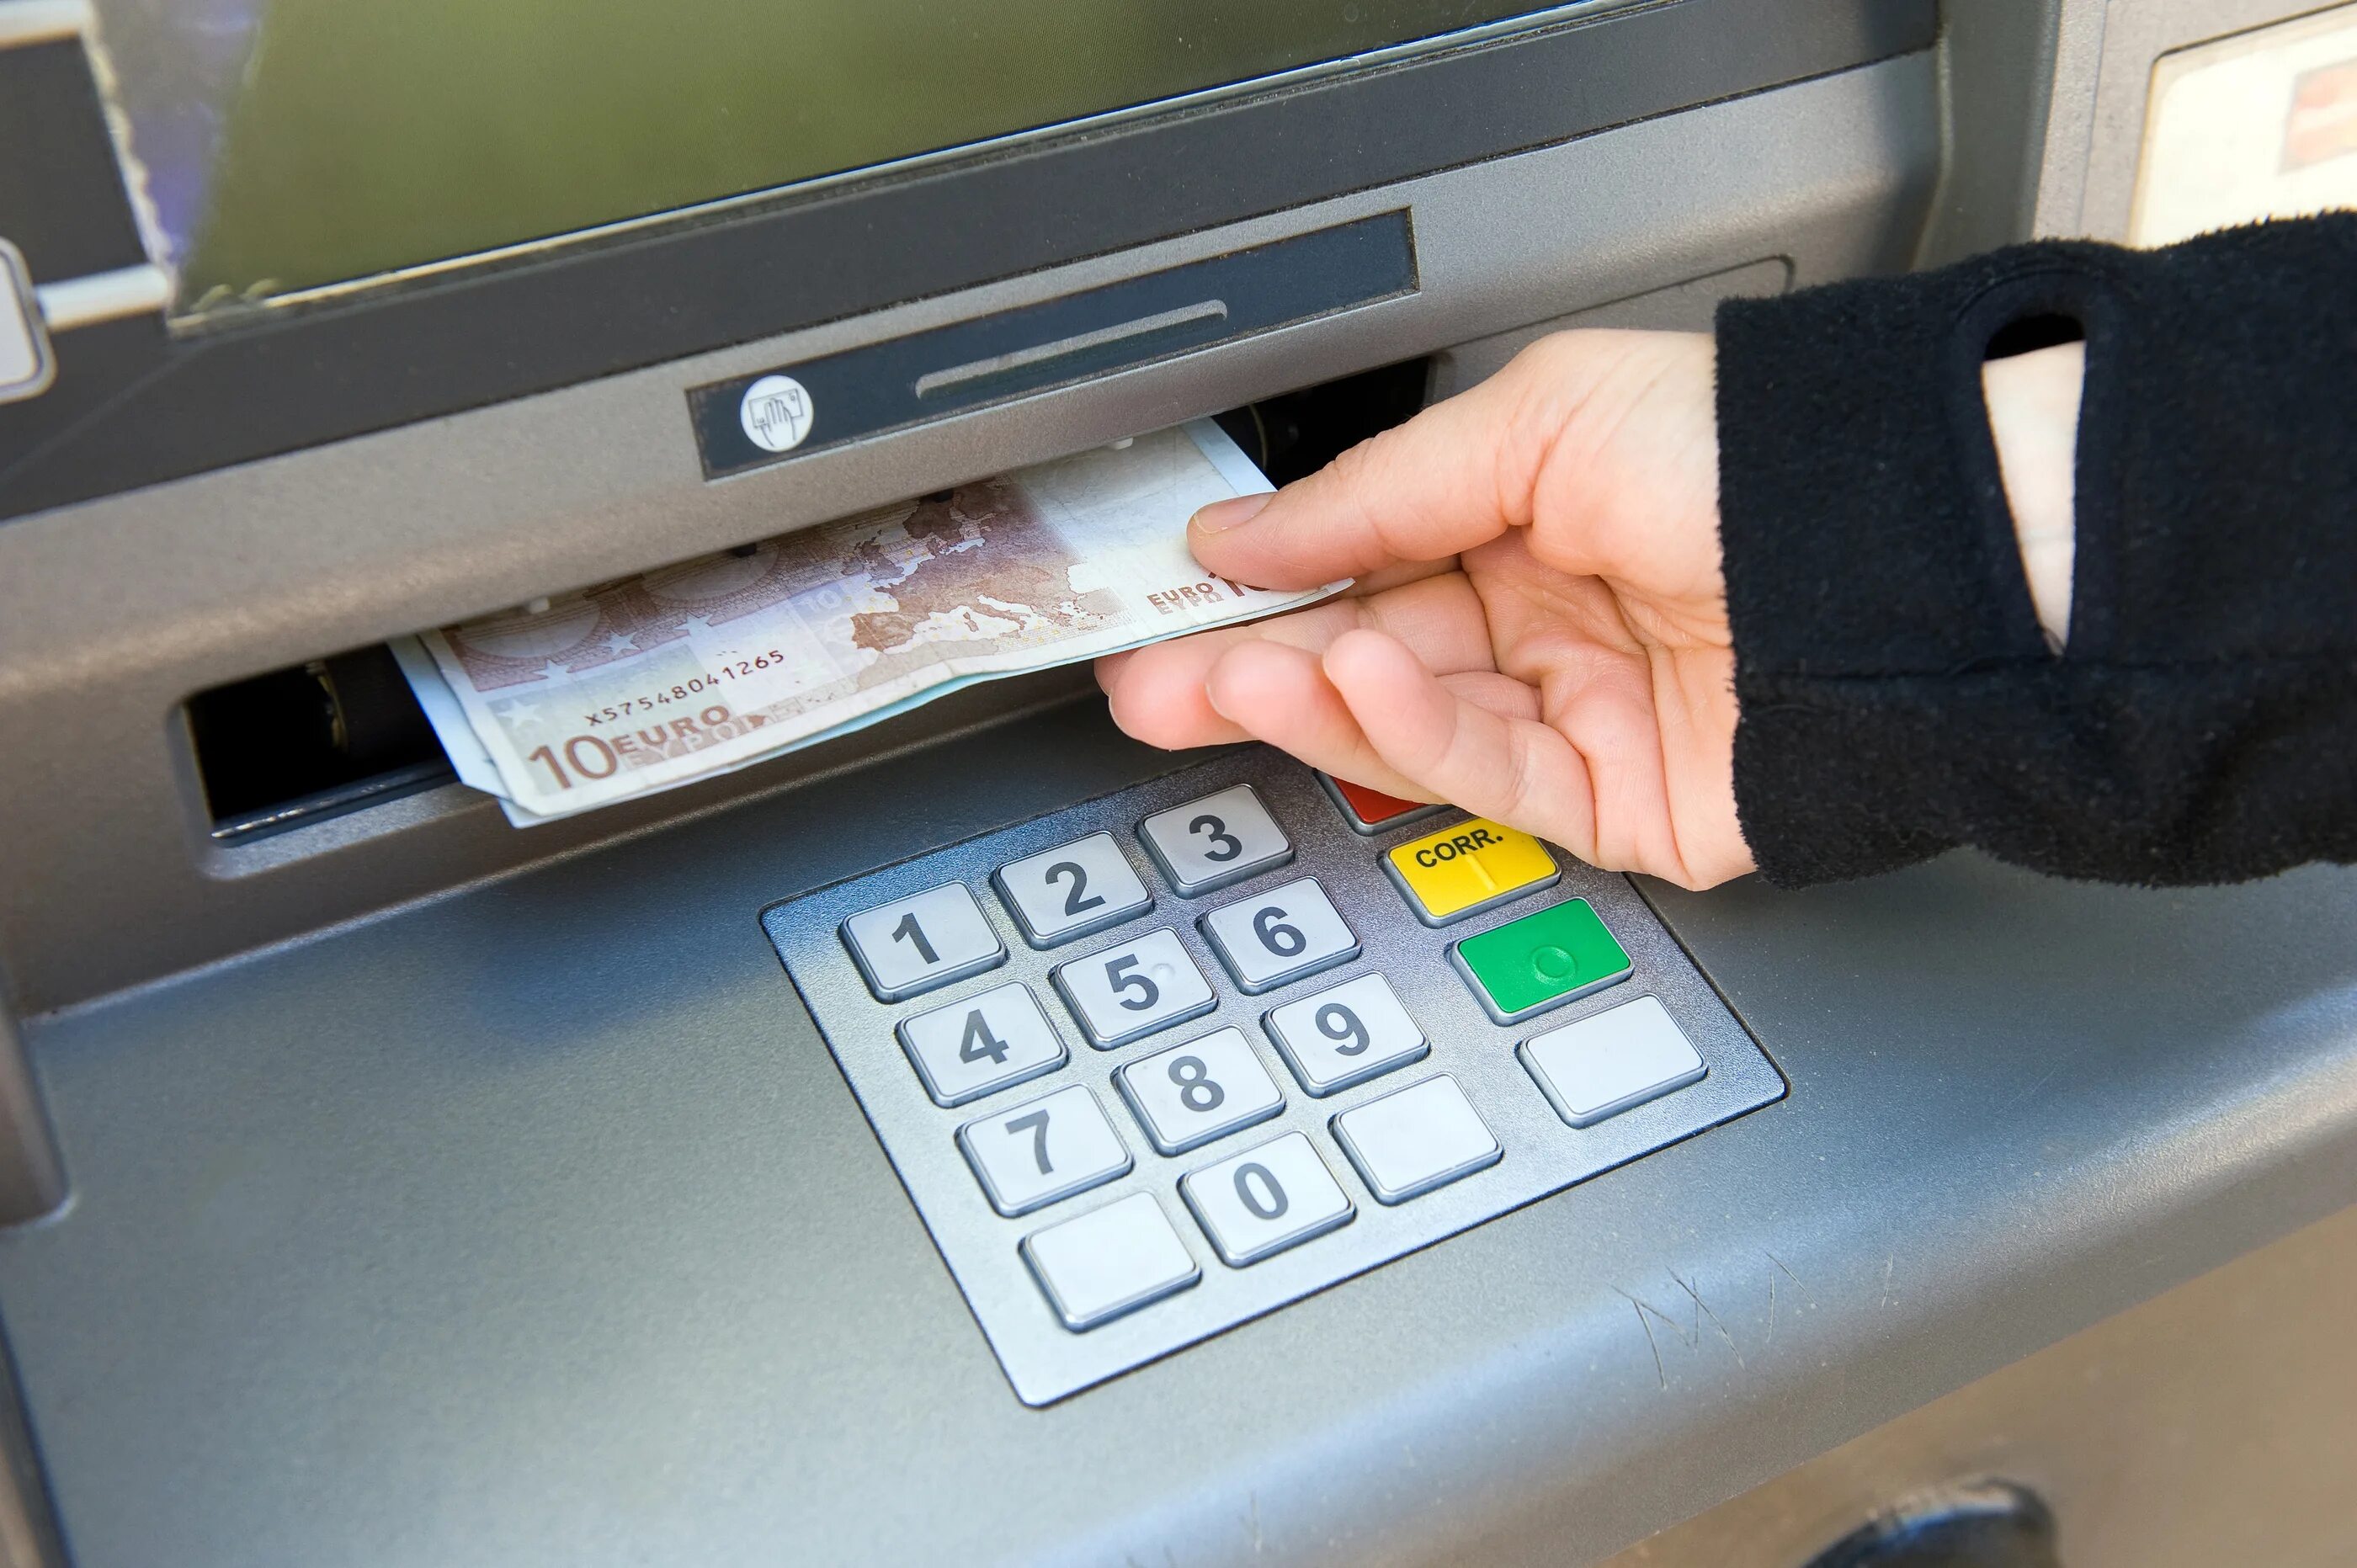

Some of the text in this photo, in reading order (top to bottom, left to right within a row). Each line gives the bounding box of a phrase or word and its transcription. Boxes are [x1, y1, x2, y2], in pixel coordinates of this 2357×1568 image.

[1147, 582, 1214, 606] EURO
[584, 650, 785, 727] X57548041265
[528, 704, 731, 789] 10 EURO
[1189, 814, 1242, 862] 3
[1416, 829, 1503, 868] CORR.
[1045, 862, 1106, 917] 2
[892, 913, 939, 965] 1
[1253, 906, 1306, 958] 6
[1108, 954, 1159, 1011] 5
[960, 1009, 1009, 1064] 4
[1315, 1002, 1370, 1056] 9
[1168, 1055, 1224, 1113] 8
[1005, 1109, 1054, 1175] 7
[1233, 1162, 1289, 1220] 0
